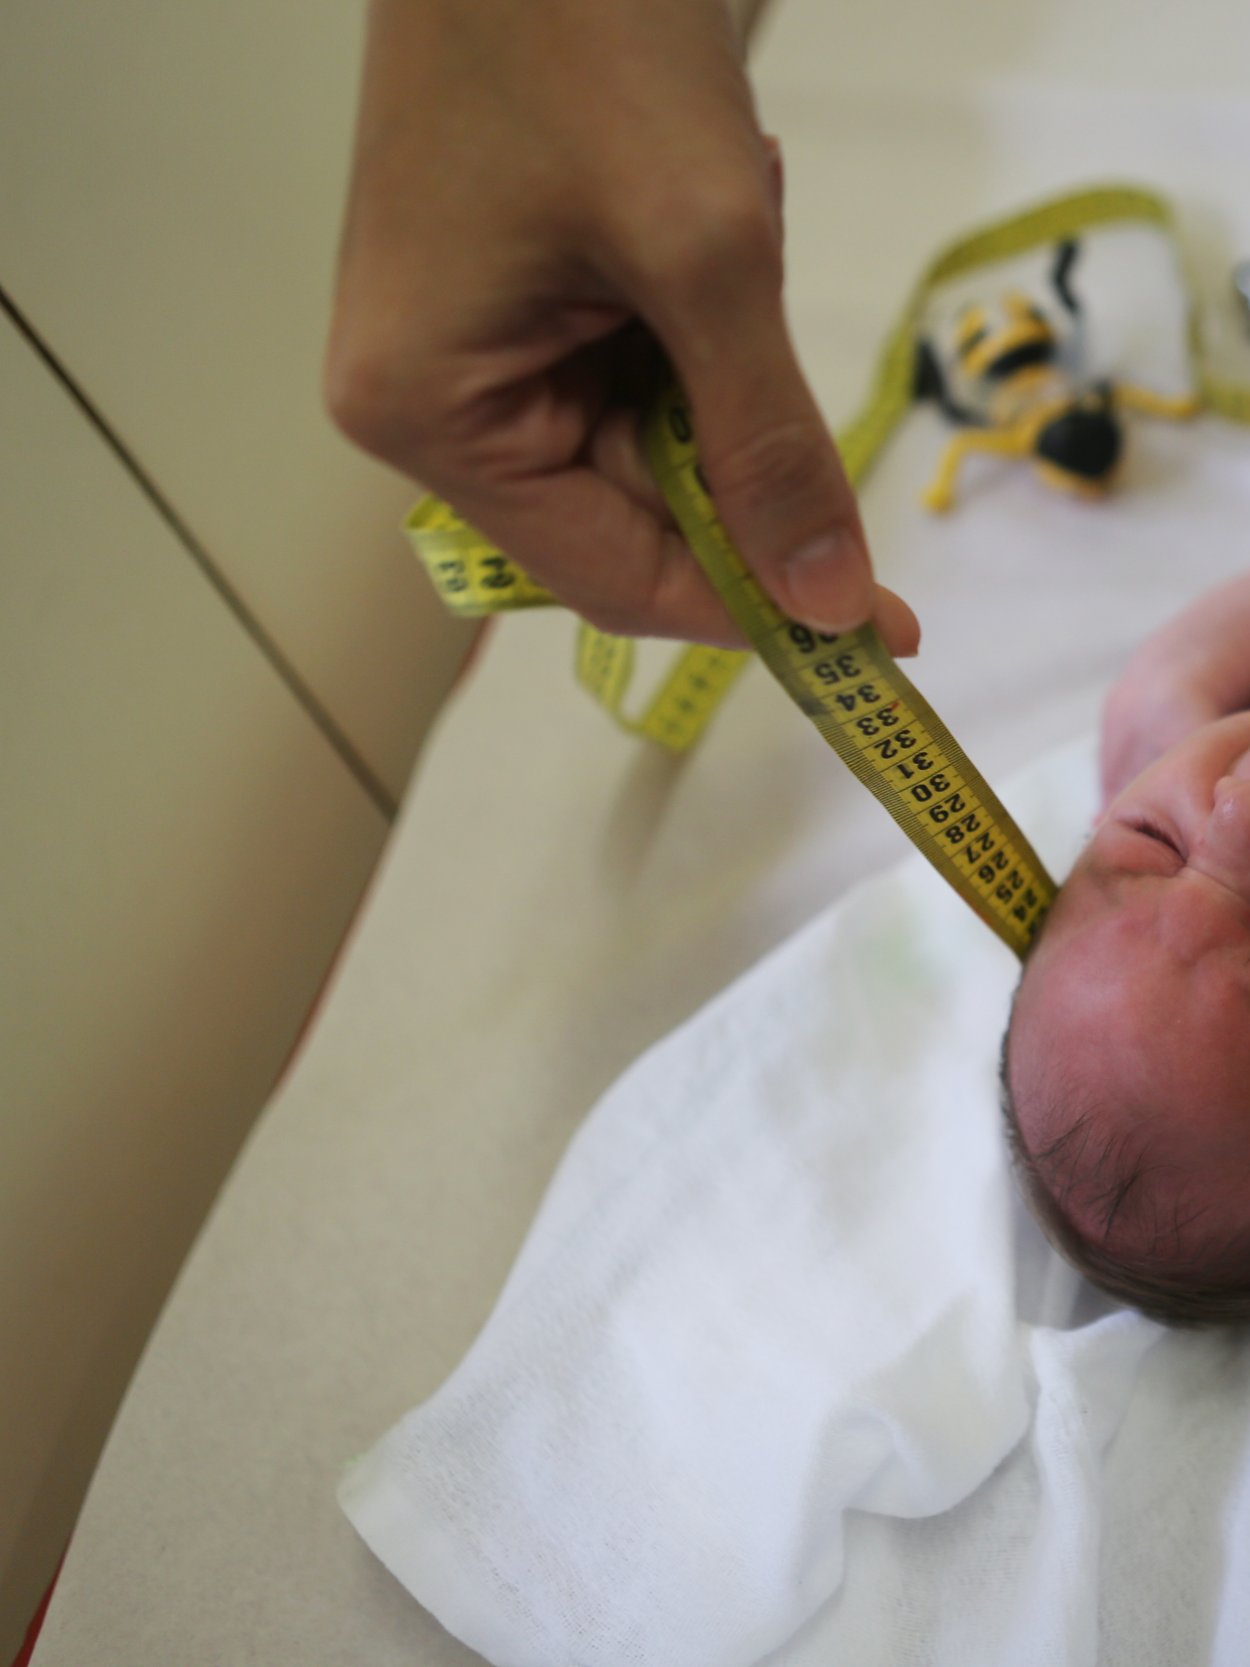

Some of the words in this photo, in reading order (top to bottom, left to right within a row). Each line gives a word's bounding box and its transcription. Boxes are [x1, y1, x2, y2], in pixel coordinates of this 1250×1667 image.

[814, 655, 862, 685] 35
[836, 684, 881, 711] 34
[857, 708, 900, 736] 33
[873, 728, 918, 760] 32
[899, 751, 935, 780] 31
[912, 774, 951, 804] 30
[930, 793, 967, 824] 29
[945, 816, 981, 845] 28
[966, 832, 995, 864] 27
[978, 850, 1009, 884] 26
[996, 869, 1024, 904] 25
